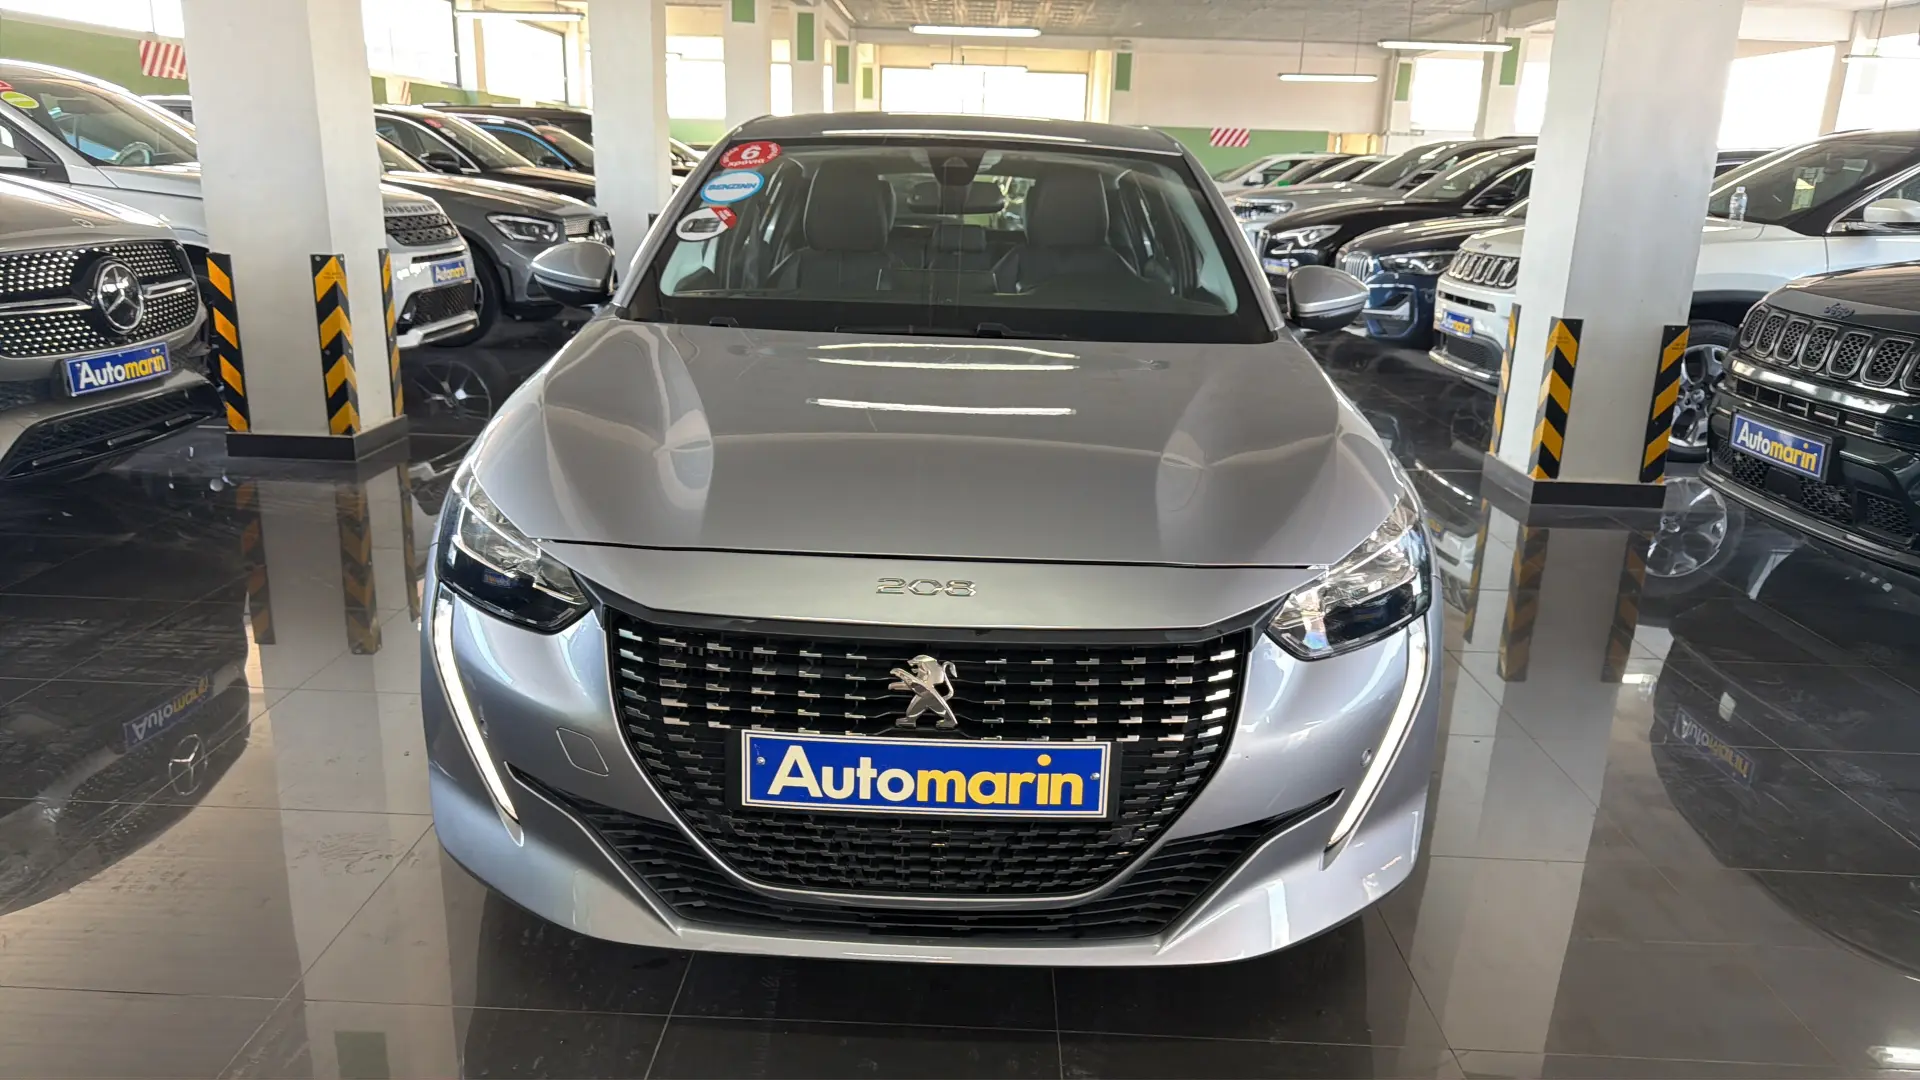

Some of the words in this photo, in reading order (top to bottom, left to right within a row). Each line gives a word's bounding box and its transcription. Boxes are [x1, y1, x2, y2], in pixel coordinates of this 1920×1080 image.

[741, 144, 762, 160] 6
[79, 348, 166, 390] Automarin
[1736, 421, 1817, 472] Automarin
[876, 578, 976, 597] 208
[767, 745, 1084, 805] Automarin
